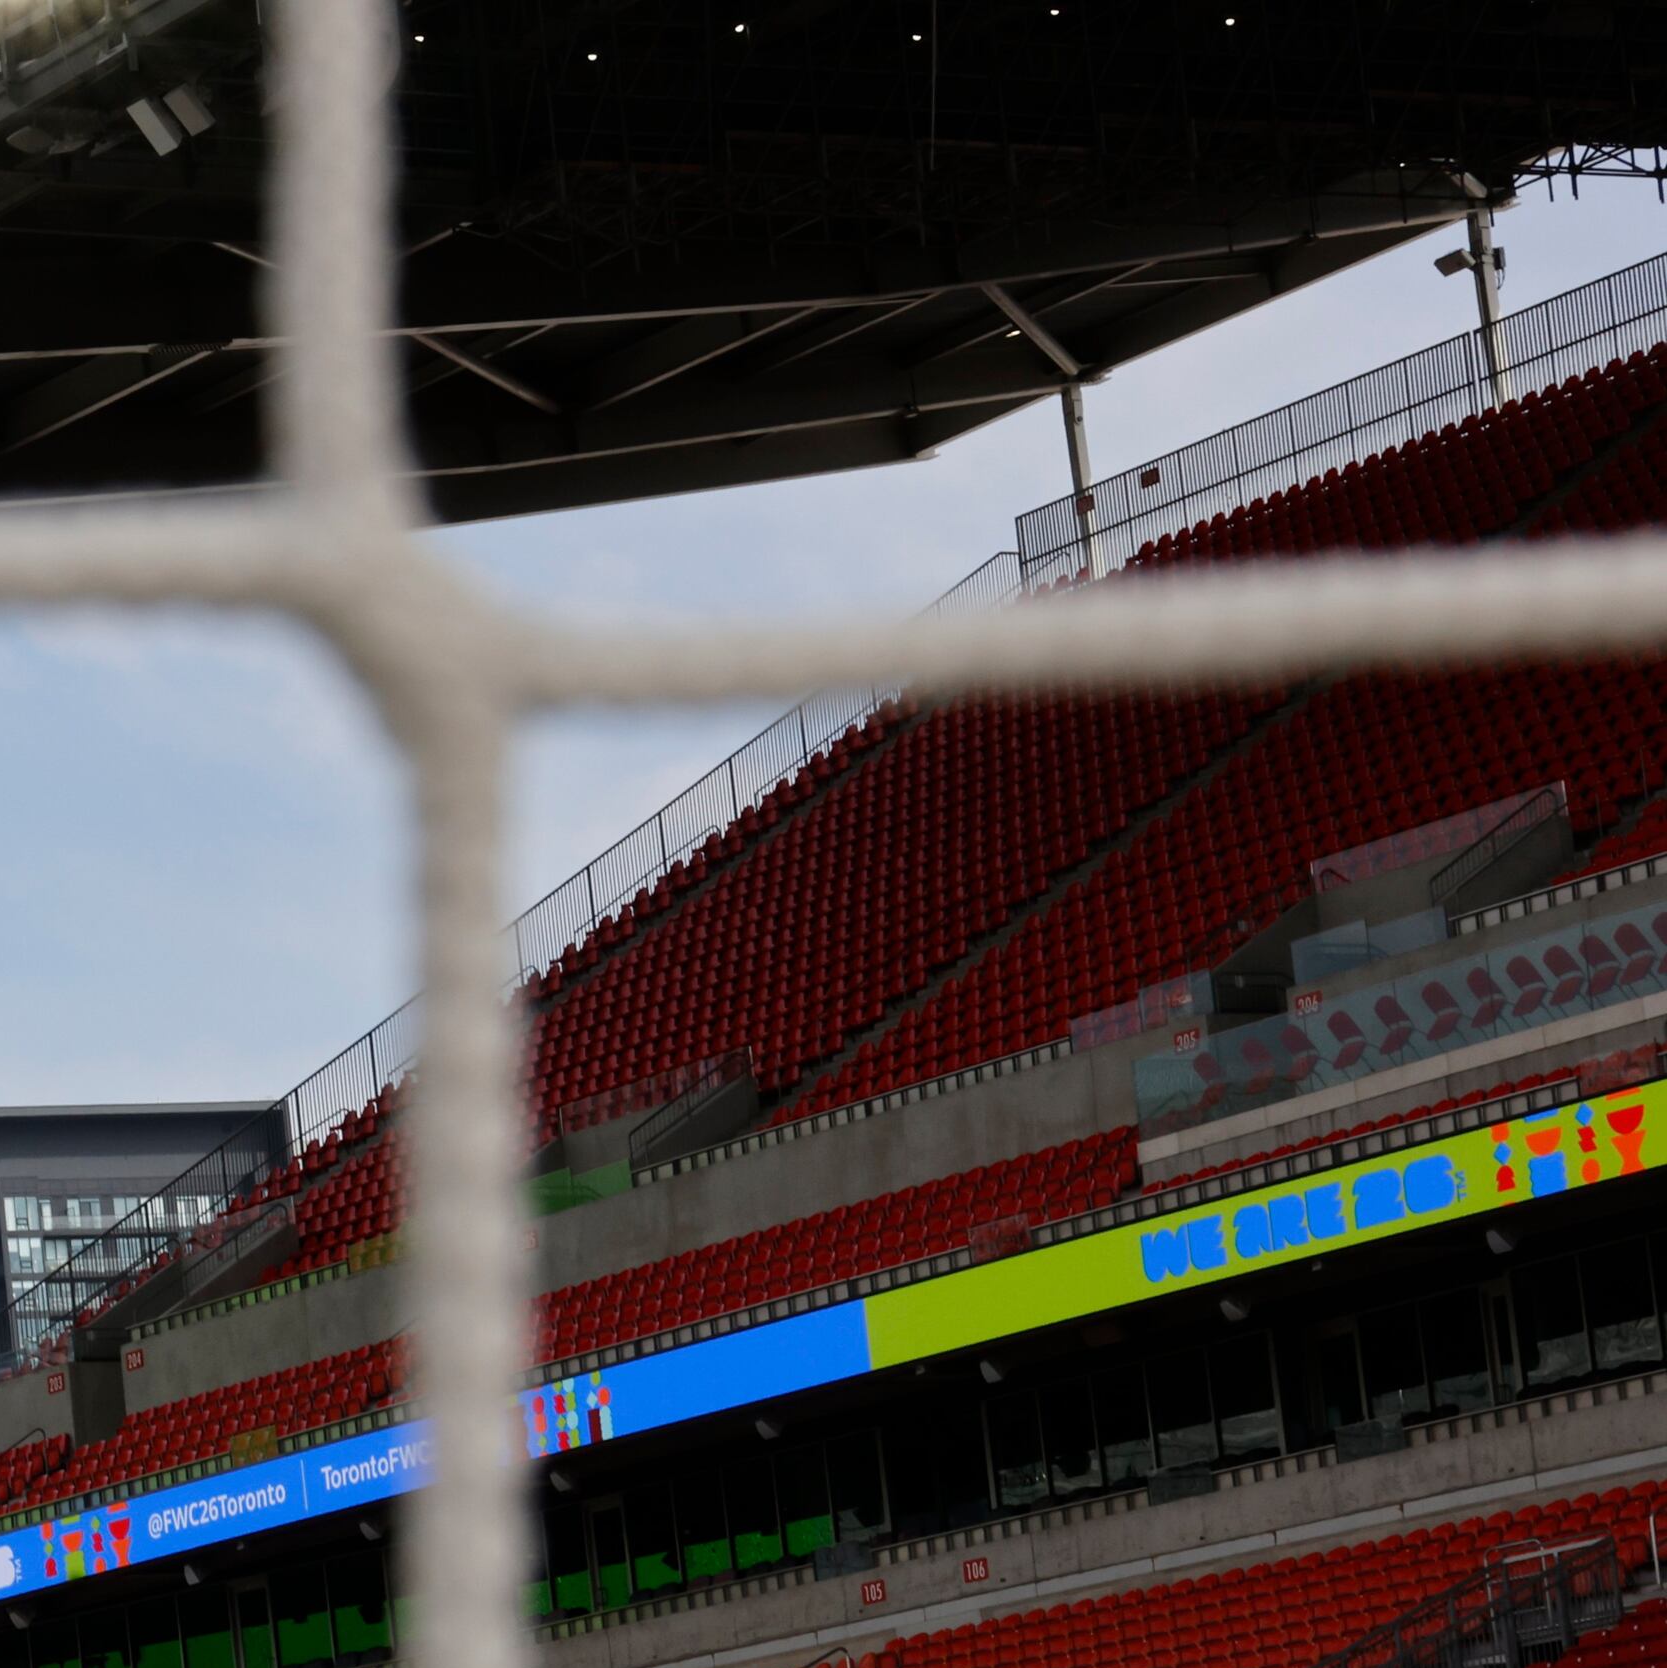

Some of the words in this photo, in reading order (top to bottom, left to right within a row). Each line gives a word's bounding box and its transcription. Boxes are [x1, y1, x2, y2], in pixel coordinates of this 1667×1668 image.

[1298, 994, 1318, 1016] 206
[1177, 1031, 1196, 1052] 205
[1140, 1215, 1228, 1283] WE
[1233, 1182, 1347, 1259] ARE
[1353, 1154, 1456, 1230] 26
[127, 1351, 142, 1370] 204
[49, 1375, 64, 1394] 203
[320, 1440, 433, 1492] TorontoFWC
[147, 1481, 287, 1540] @FWC26Toronto
[967, 1561, 986, 1581] 106
[864, 1582, 883, 1603] 105
